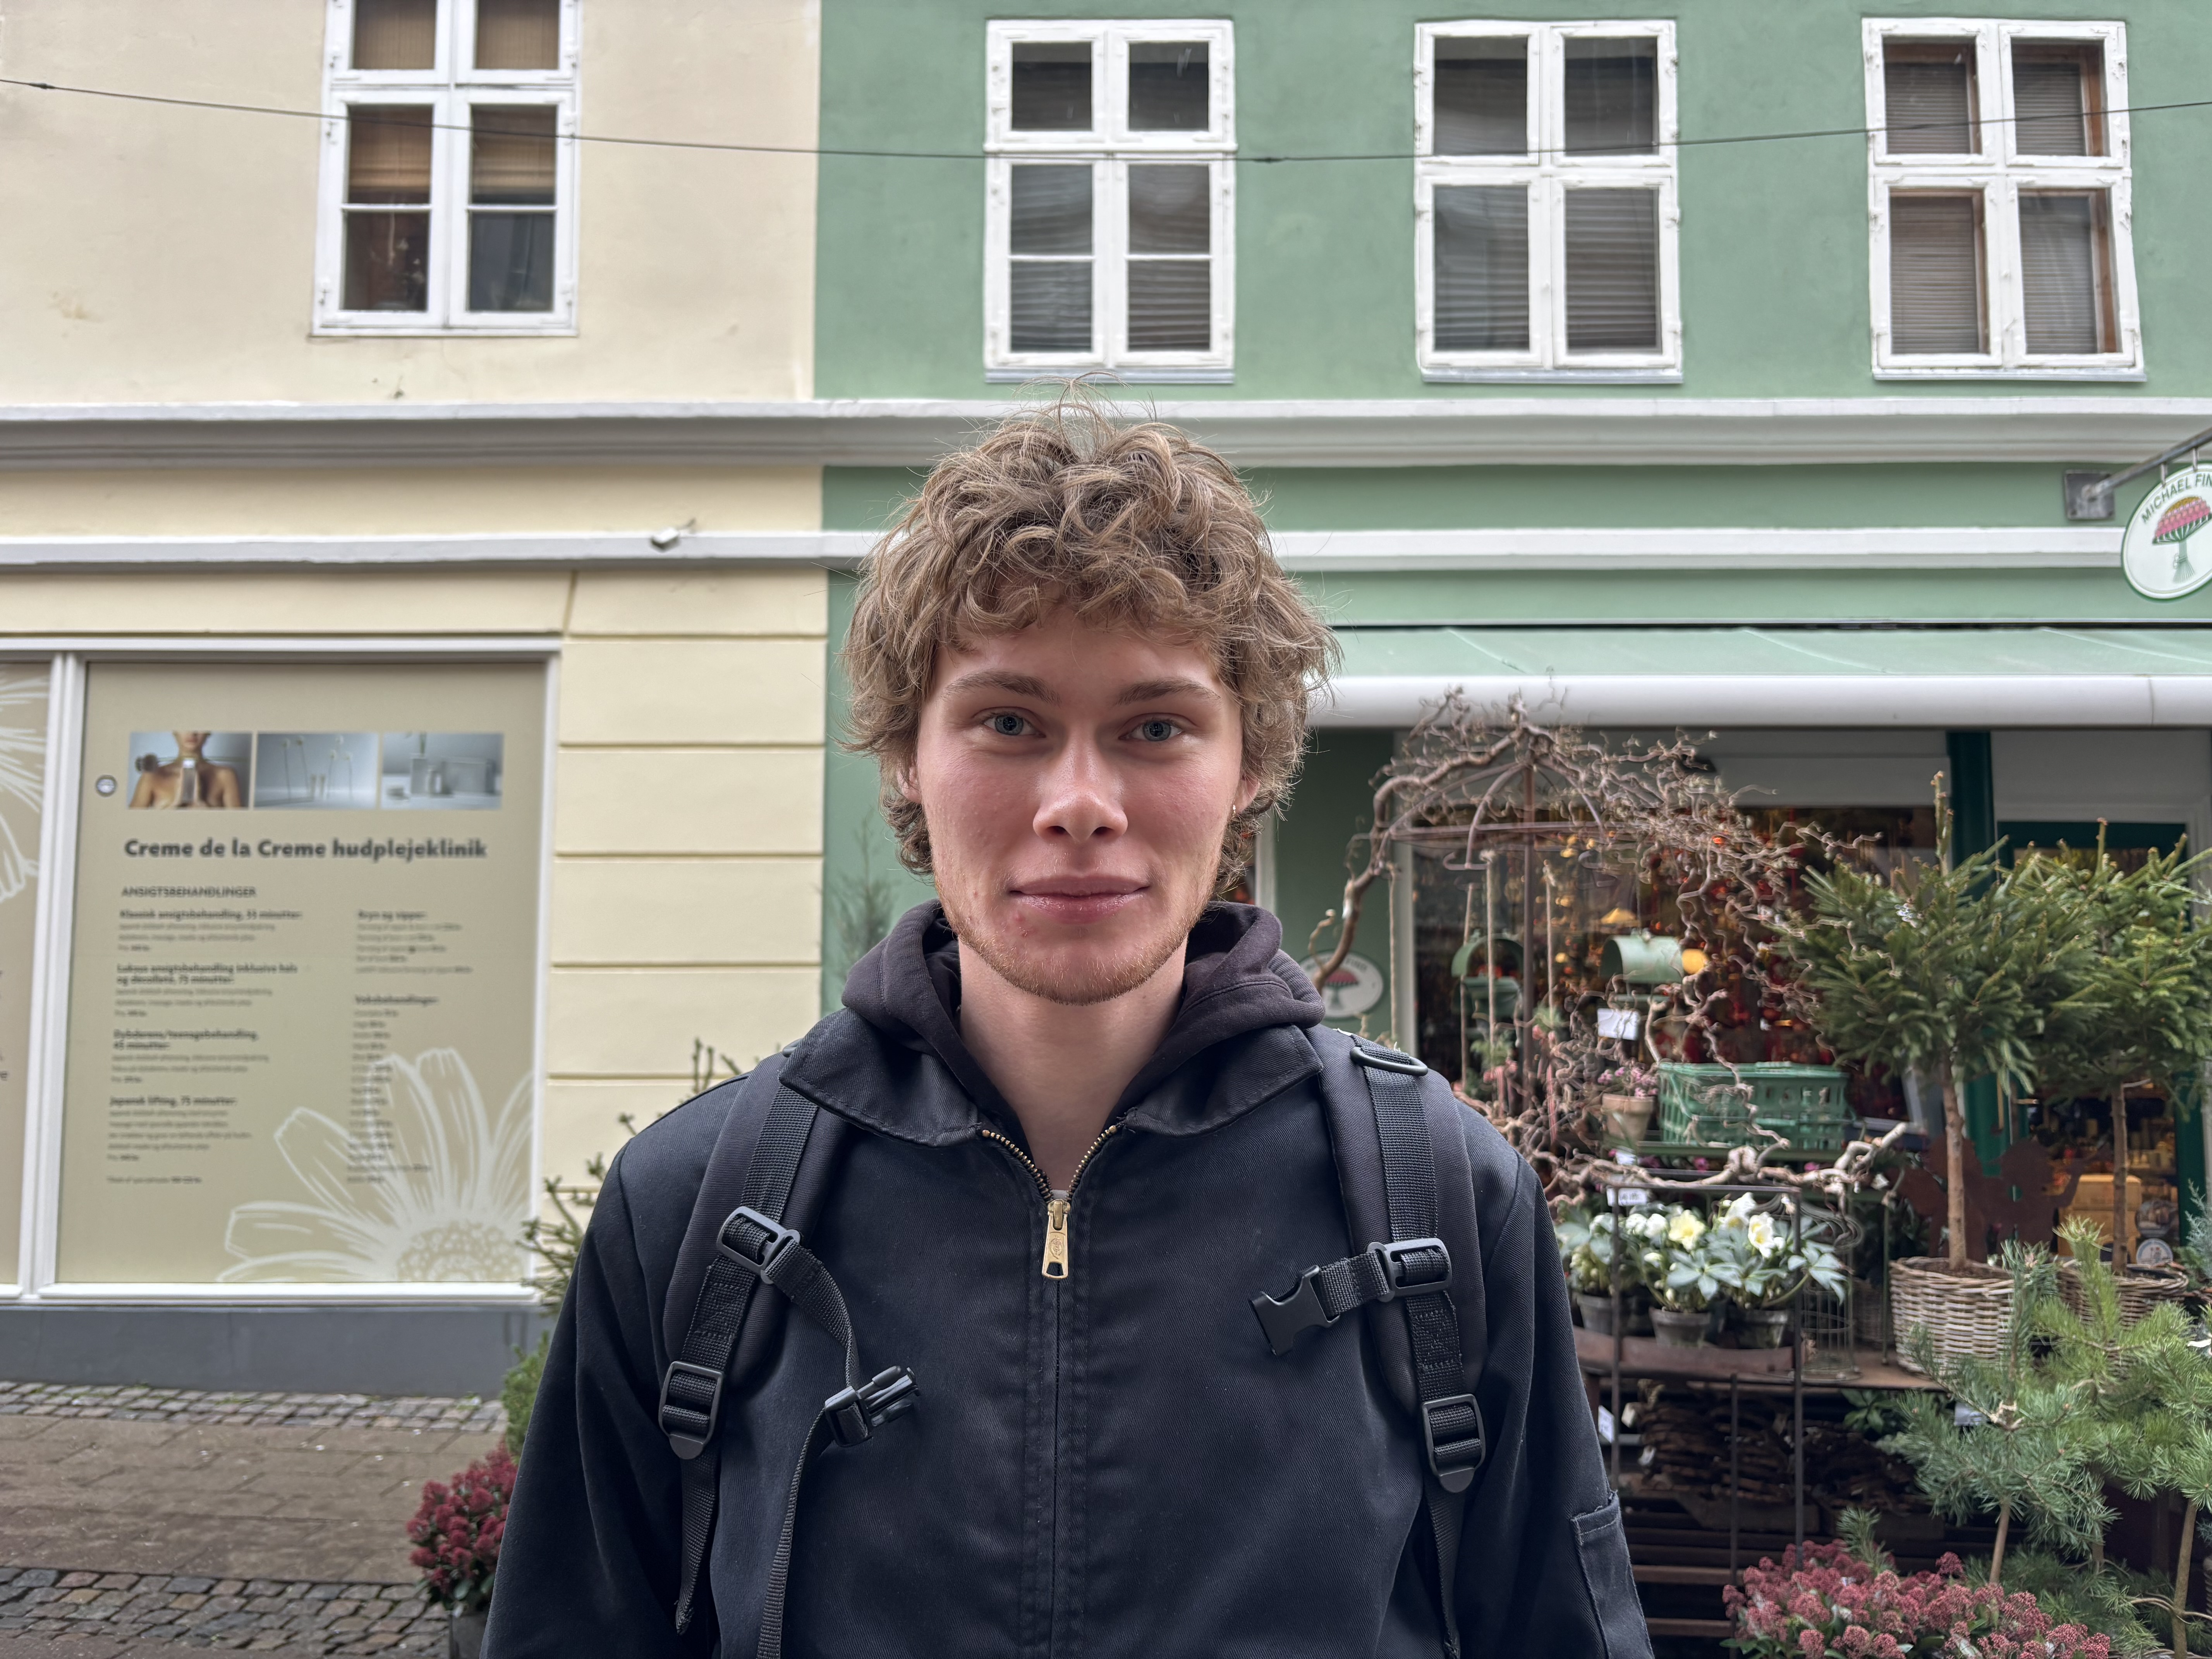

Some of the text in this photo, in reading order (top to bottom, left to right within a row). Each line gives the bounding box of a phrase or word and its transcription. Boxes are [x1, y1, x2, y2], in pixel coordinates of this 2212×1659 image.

[2142, 477, 2191, 524] MICHAEL
[124, 837, 487, 862] Creme de la Creme hudplejeklinik
[121, 886, 256, 898] ANSIGTSBEHANDLINGER
[117, 976, 129, 986] og
